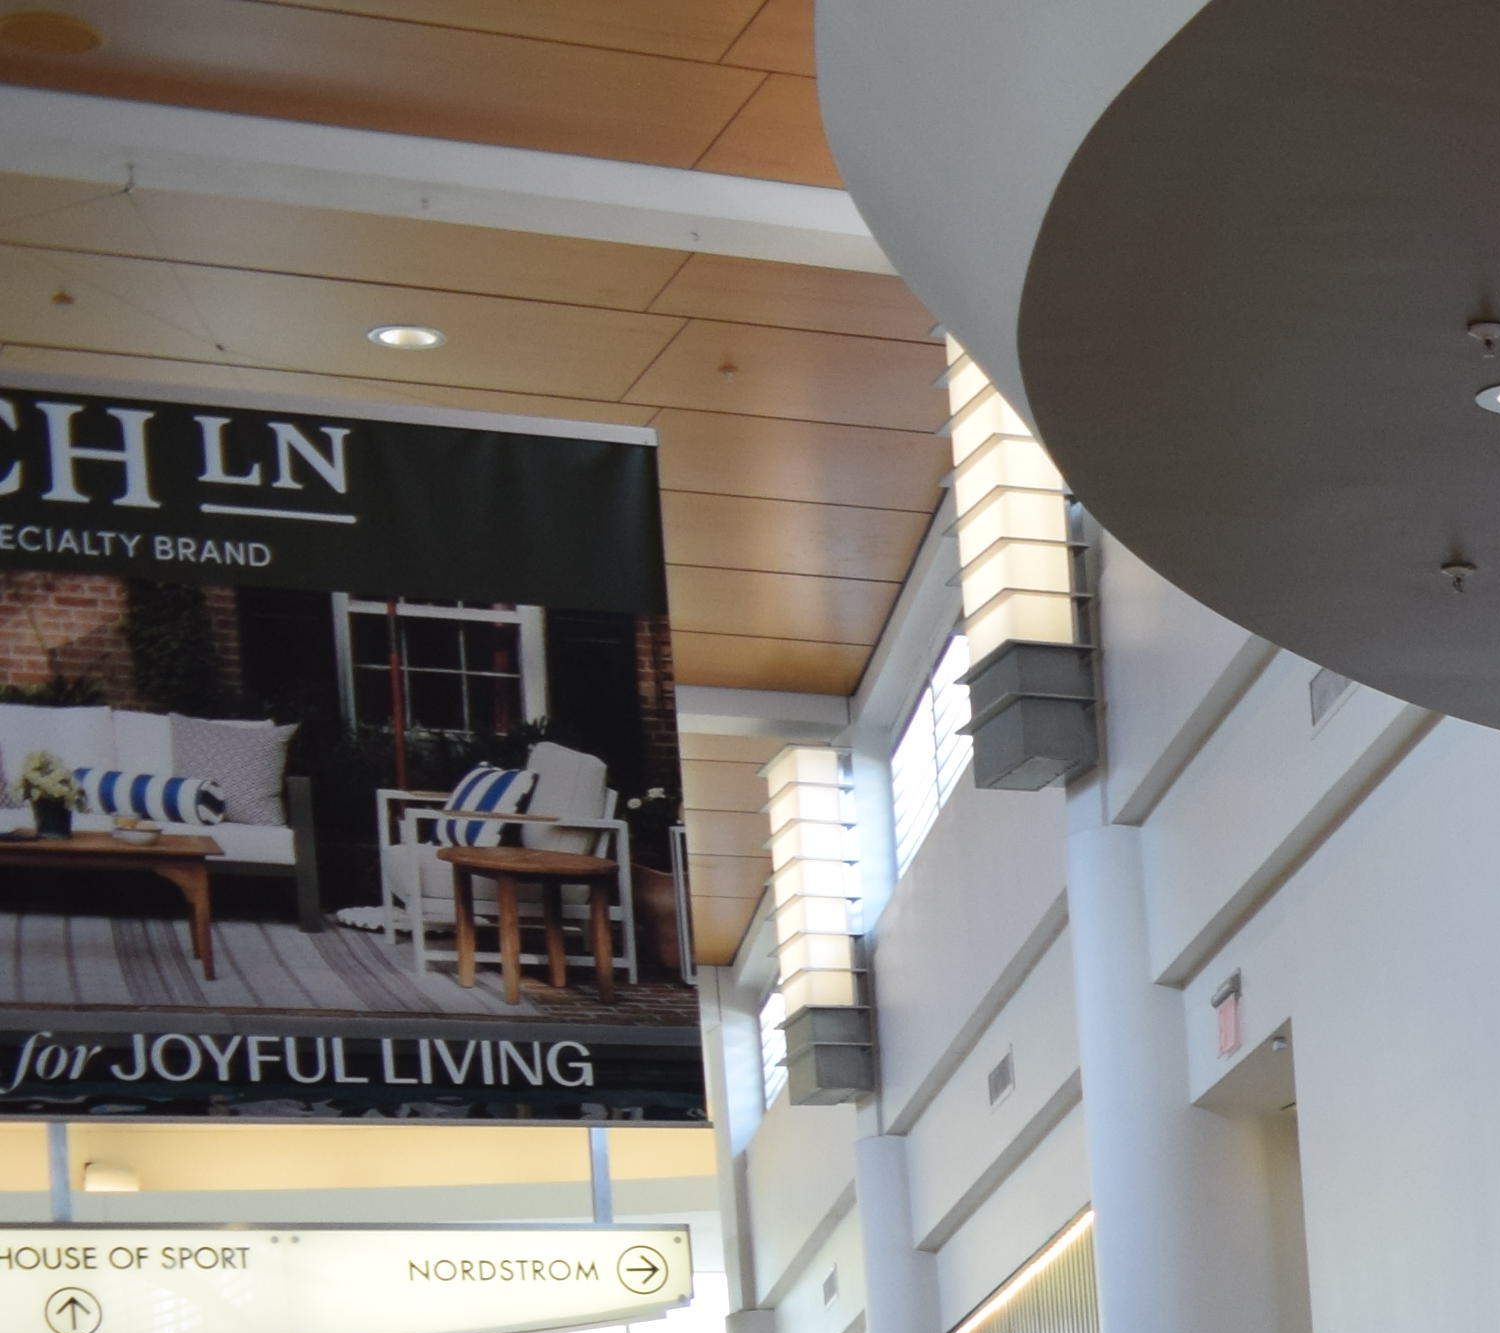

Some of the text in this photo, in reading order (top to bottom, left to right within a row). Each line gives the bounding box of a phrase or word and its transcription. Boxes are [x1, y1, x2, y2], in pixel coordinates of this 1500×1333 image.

[194, 415, 352, 495] LN
[154, 536, 272, 568] BRAND
[2, 1031, 594, 1094] for JOYFUL LIVING
[0, 1246, 251, 1271] HOUSE OF SPORT
[408, 1259, 600, 1283] NORDSTROM
